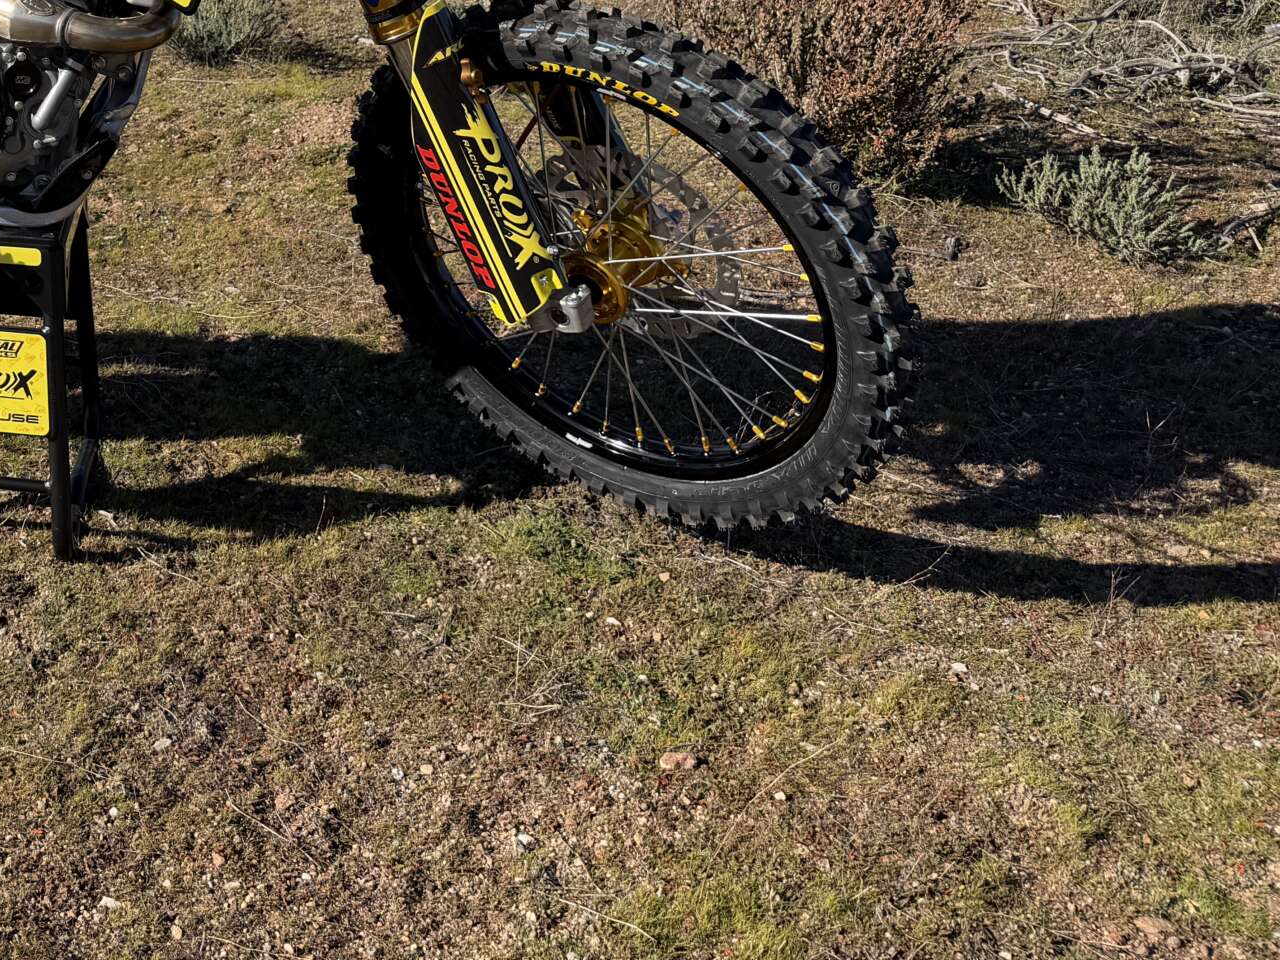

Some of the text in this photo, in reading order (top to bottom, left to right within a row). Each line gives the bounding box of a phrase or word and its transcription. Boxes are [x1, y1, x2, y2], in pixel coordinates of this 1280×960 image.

[539, 60, 680, 118] DUNLOP
[416, 143, 496, 290] DUNLOP
[461, 139, 502, 219] RACING PARTS
